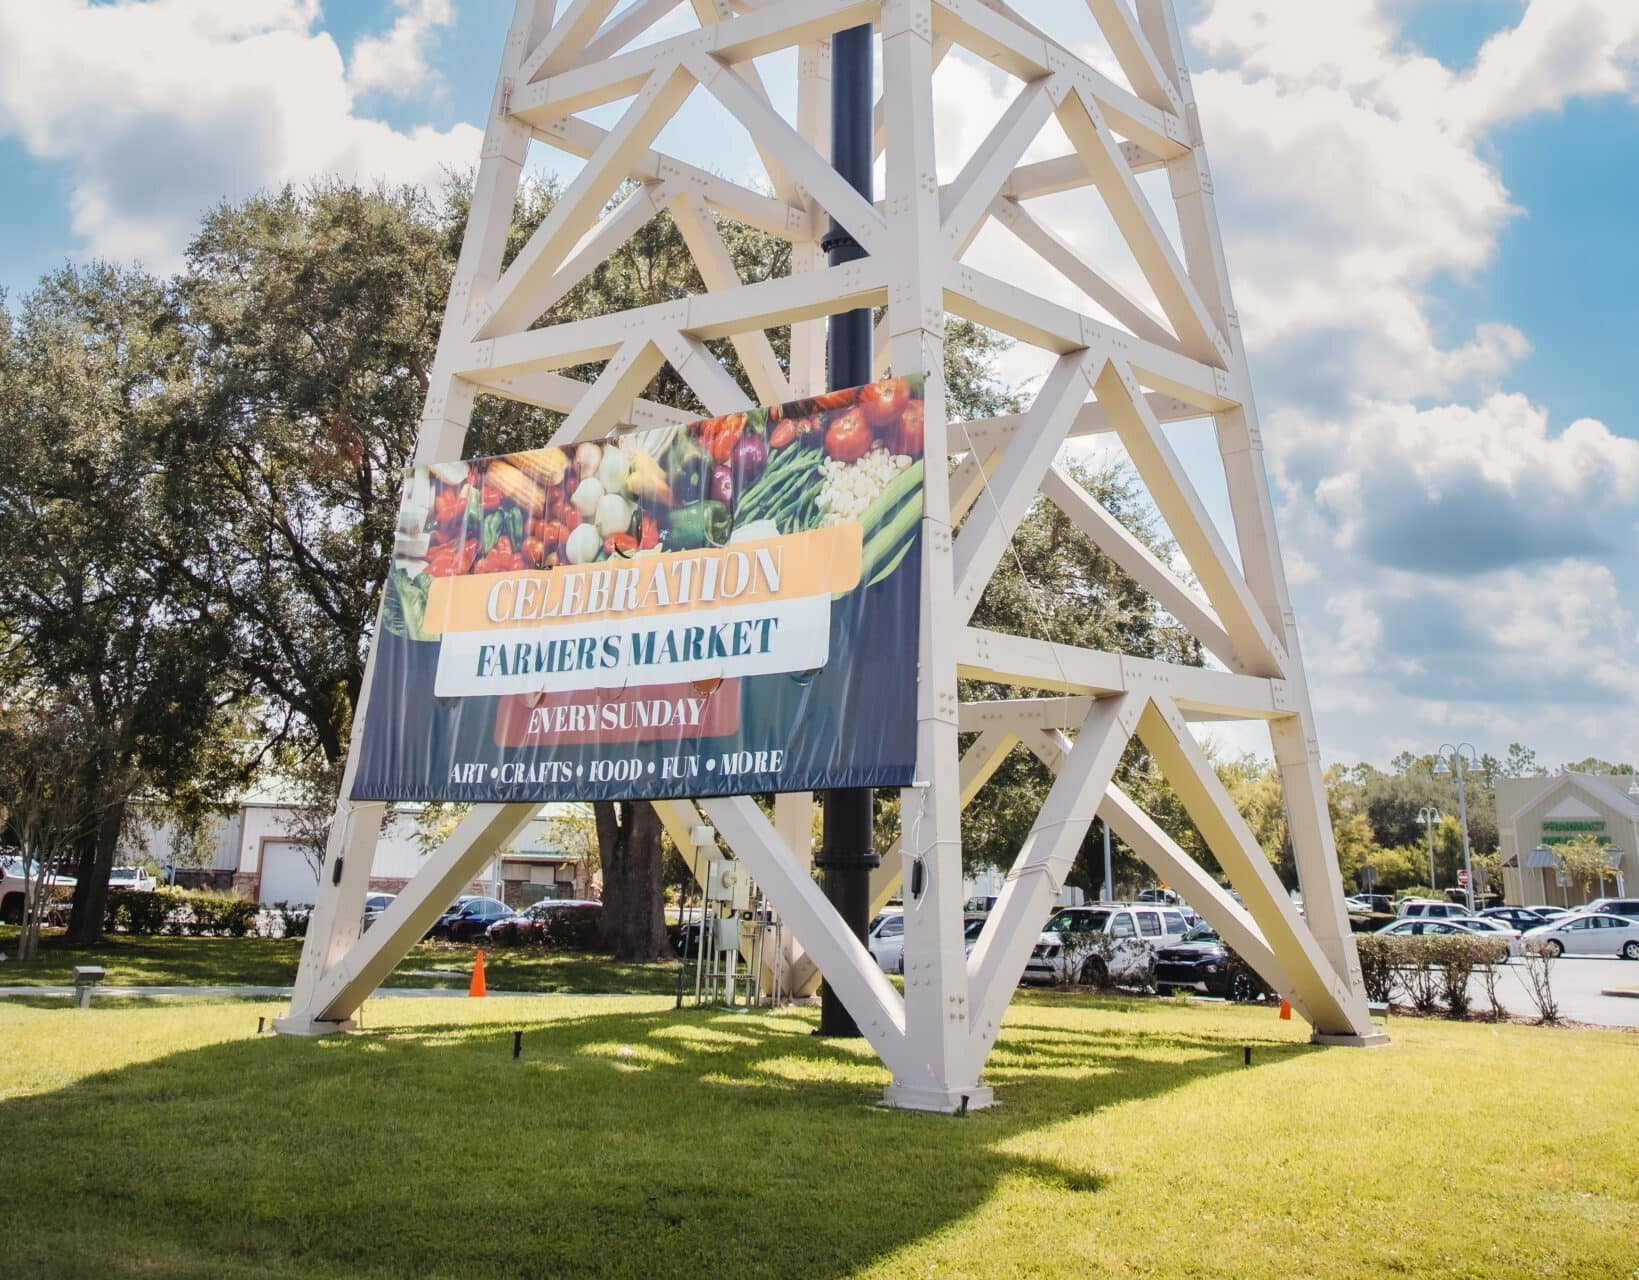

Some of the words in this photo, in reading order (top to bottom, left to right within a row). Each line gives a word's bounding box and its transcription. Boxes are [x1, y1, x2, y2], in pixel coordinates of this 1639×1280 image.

[487, 546, 783, 623] CELEBRATION
[626, 617, 779, 665] MARKET
[528, 702, 599, 734] EVERY
[600, 698, 705, 730] SUNDAY
[450, 762, 488, 784] ART
[501, 761, 573, 784] CRAFTS
[589, 758, 643, 782] FOOD
[661, 755, 701, 779] FUN
[719, 749, 784, 776] MORE
